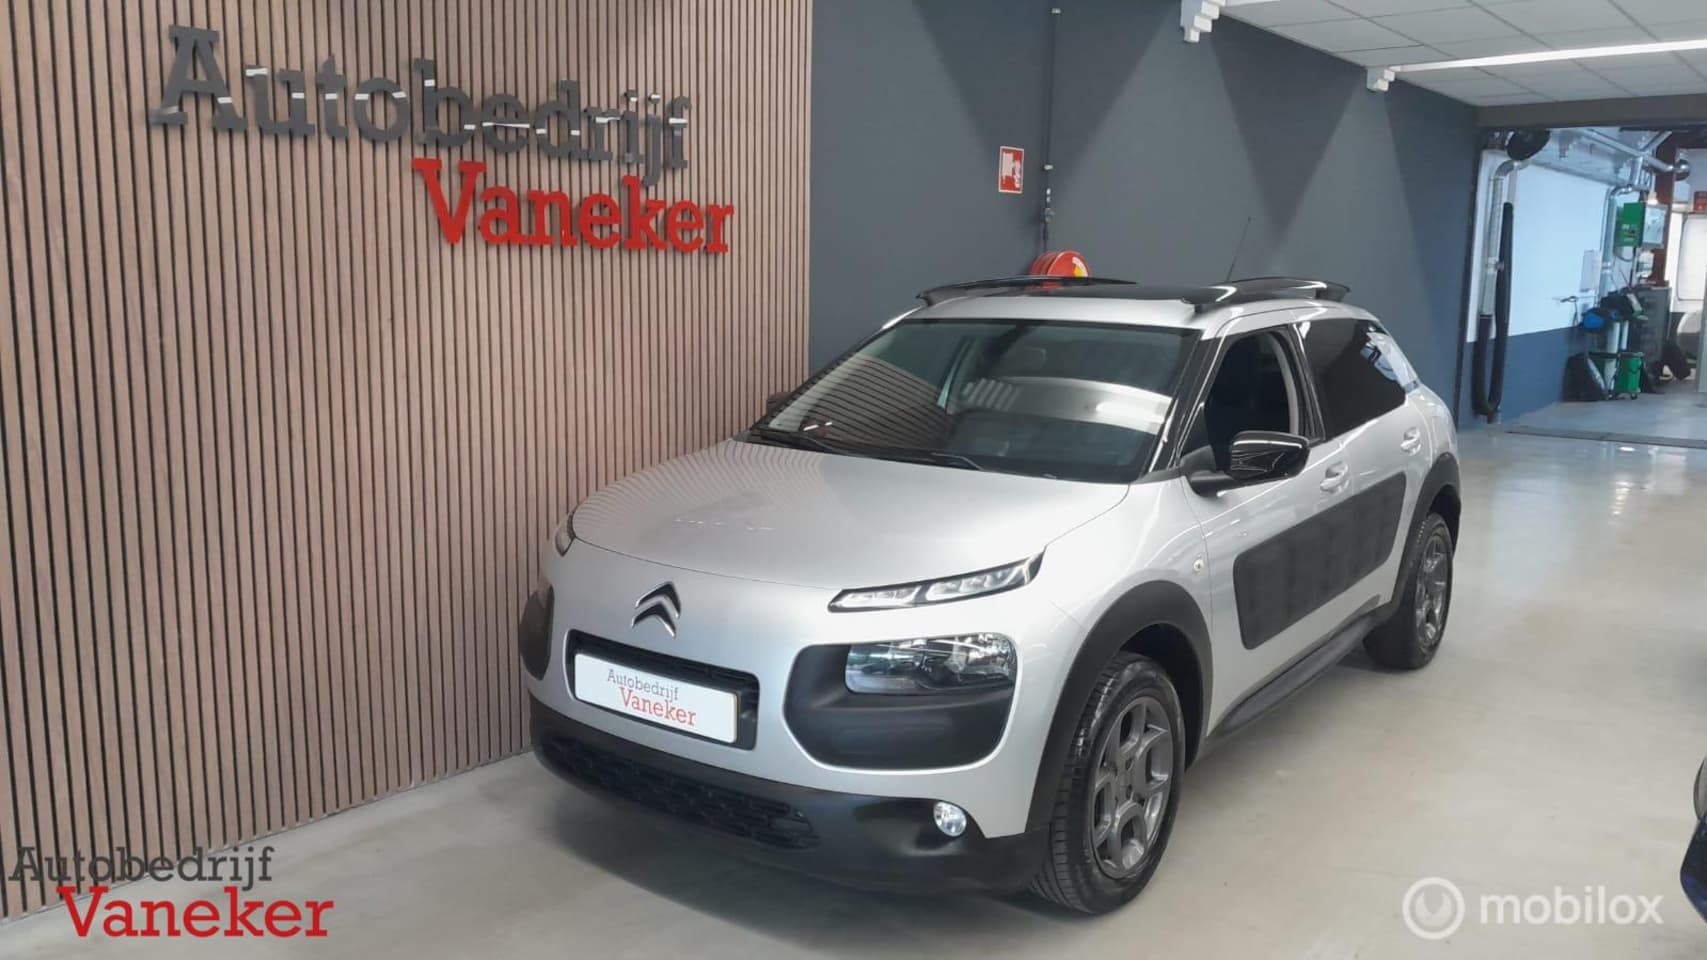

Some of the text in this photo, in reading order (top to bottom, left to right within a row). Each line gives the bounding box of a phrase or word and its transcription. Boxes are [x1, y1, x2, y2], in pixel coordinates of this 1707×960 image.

[151, 25, 692, 187] Autobedrijf
[411, 157, 734, 254] Vaneker
[607, 668, 680, 703] Autobedrijf
[619, 686, 697, 726] Vaneker
